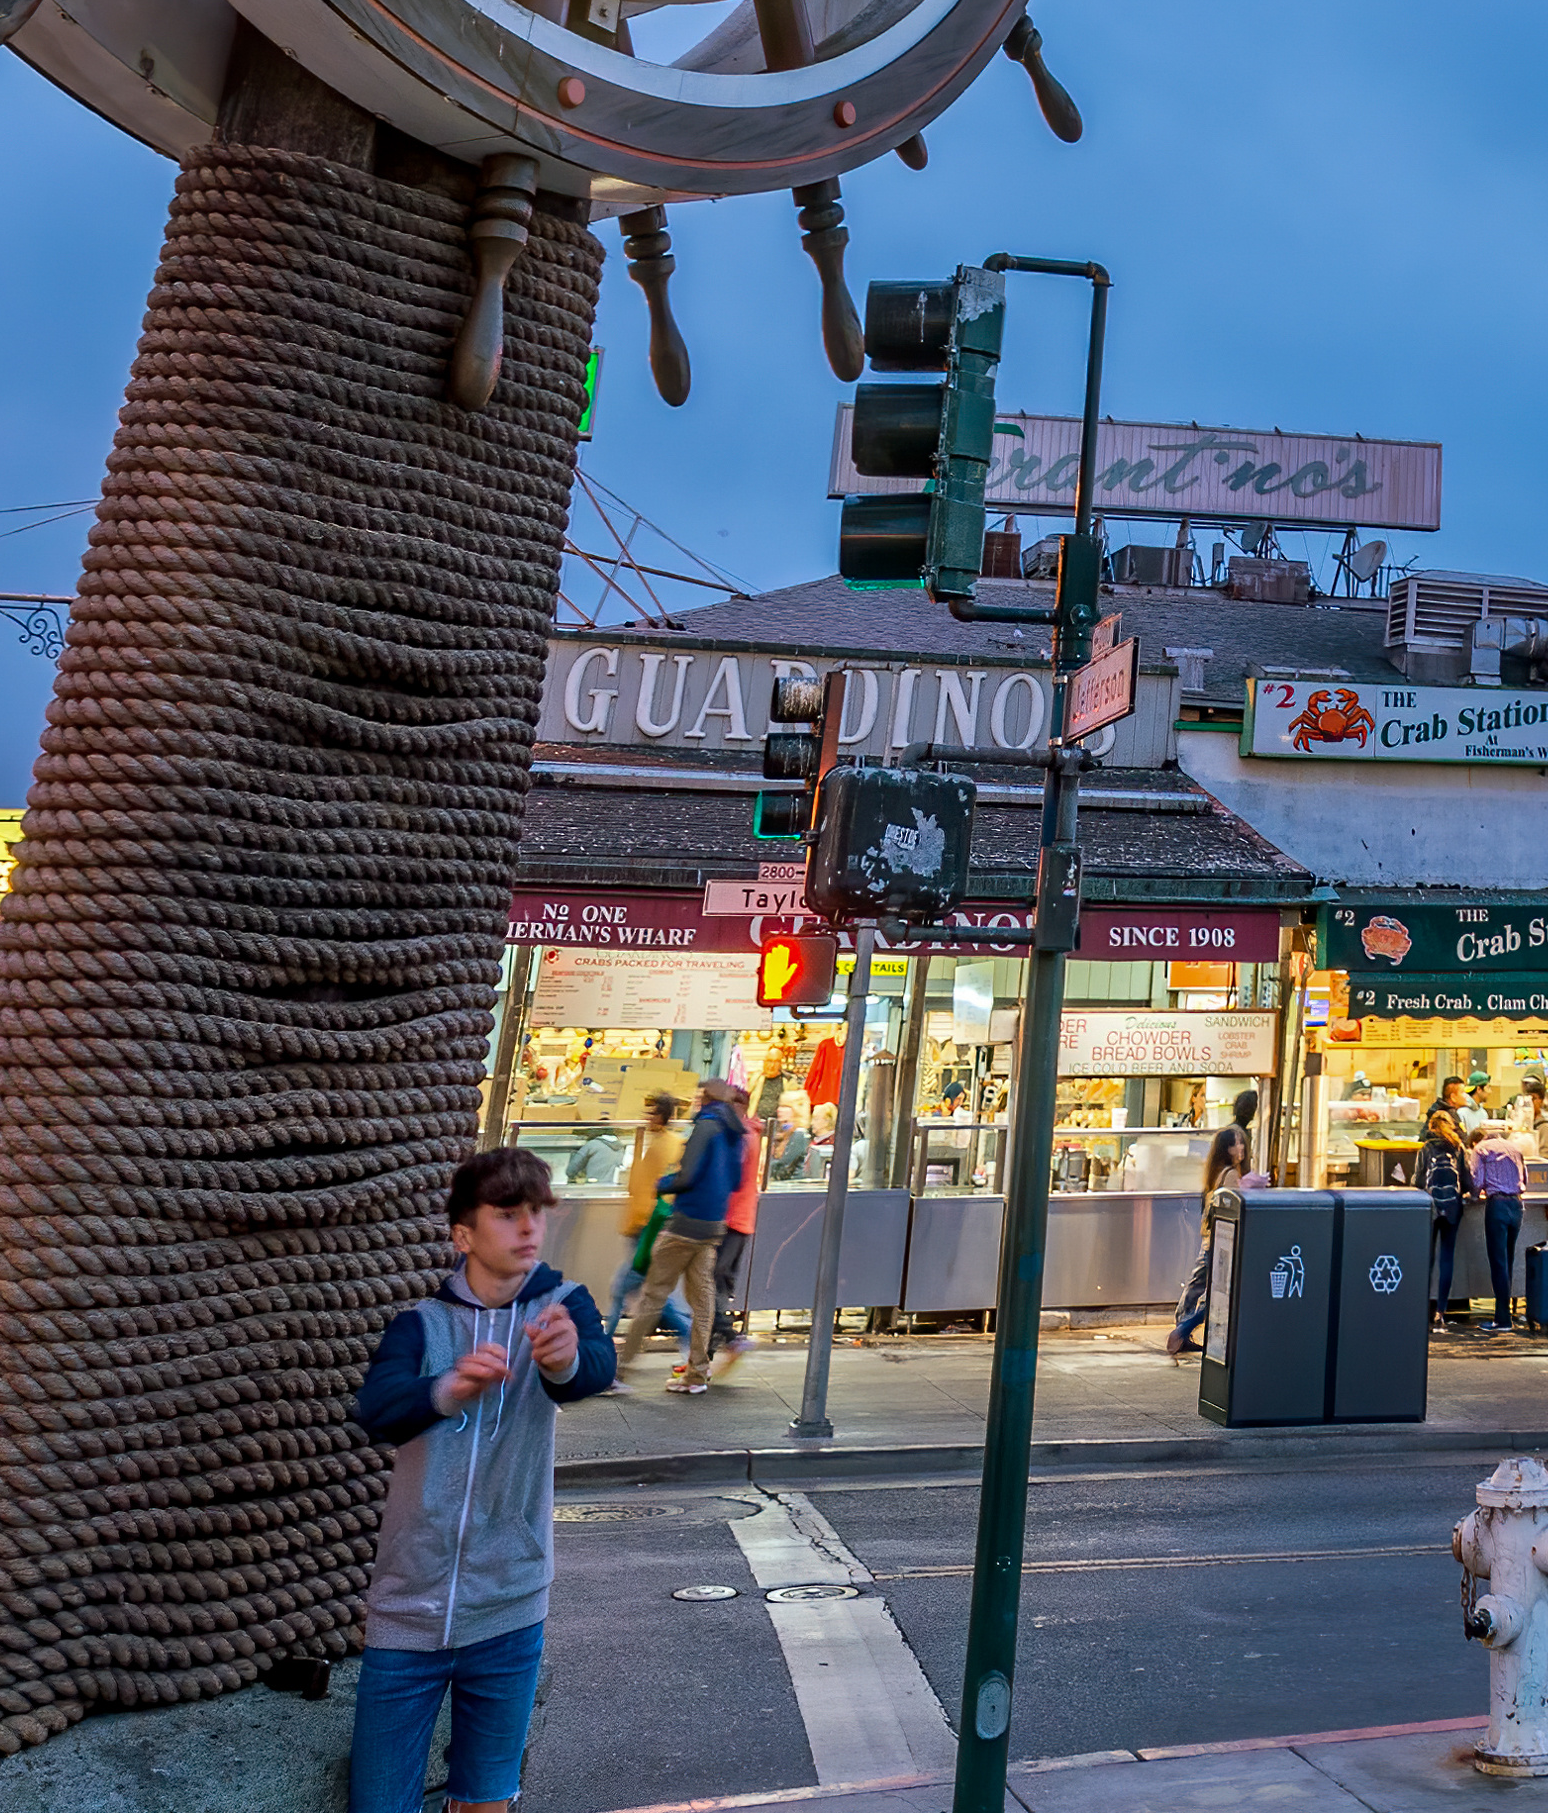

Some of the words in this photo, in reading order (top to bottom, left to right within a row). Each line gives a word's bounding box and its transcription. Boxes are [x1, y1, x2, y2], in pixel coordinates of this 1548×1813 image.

[1263, 683, 1296, 709] #2
[1382, 691, 1417, 708] THE
[1380, 713, 1448, 749] Crab
[1465, 745, 1535, 758] Fisherman's
[761, 865, 796, 879] 2800
[742, 888, 807, 914] Tayl
[582, 905, 628, 924] ONE
[1335, 909, 1356, 927] #2
[1456, 909, 1489, 923] THE
[618, 926, 697, 946] WHARF
[1109, 926, 1180, 947] SINCE
[1189, 927, 1236, 948] 1908
[1457, 924, 1521, 962] Crab
[614, 958, 659, 969] PACKED
[1356, 990, 1375, 1006] #2
[1386, 993, 1431, 1010] Fresh
[1434, 993, 1472, 1010] Crab
[1487, 994, 1526, 1011] Clam
[1125, 1016, 1178, 1030] Delicious
[1204, 1016, 1270, 1028] SANDWICH
[1107, 1030, 1192, 1046] CHOWDER
[1092, 1046, 1147, 1062] BREAD
[1153, 1046, 1212, 1062] BOWLS
[1069, 1064, 1089, 1074] ICE
[1169, 1063, 1194, 1074] AND
[1199, 1063, 1234, 1074] SODA
